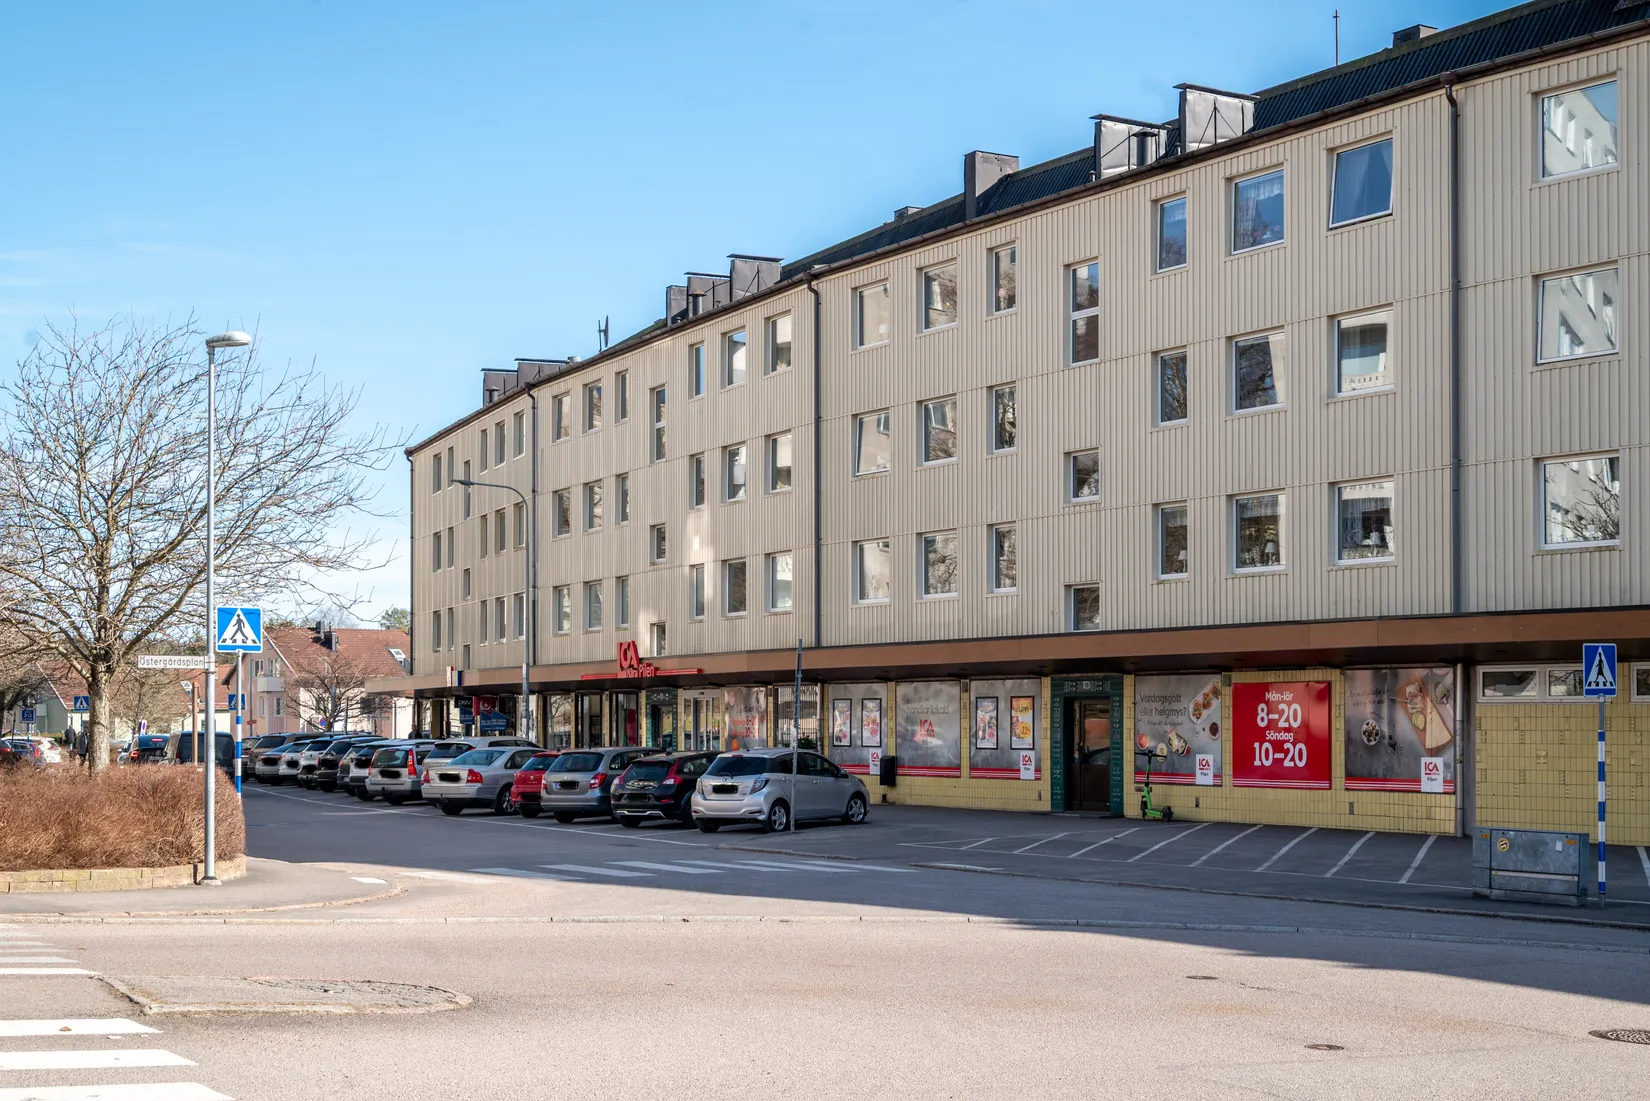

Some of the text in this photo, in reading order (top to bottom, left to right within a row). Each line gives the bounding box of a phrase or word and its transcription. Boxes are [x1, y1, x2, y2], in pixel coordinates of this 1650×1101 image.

[617, 640, 640, 669] ICA
[139, 655, 204, 668] Östergårdsplan
[638, 664, 655, 678] Pilen
[1139, 692, 1182, 705] Vardagsgott
[1265, 691, 1294, 701] Mån-lör
[1139, 706, 1187, 719] eller helgmys?
[1256, 703, 1302, 728] 8-20
[919, 719, 935, 733] ICA
[1265, 730, 1294, 743] Söndag
[871, 752, 880, 760] ICA
[1022, 754, 1033, 763] ICA
[1253, 742, 1307, 768] 10-20
[1198, 758, 1211, 767] ICA
[1424, 761, 1440, 772] ICA
